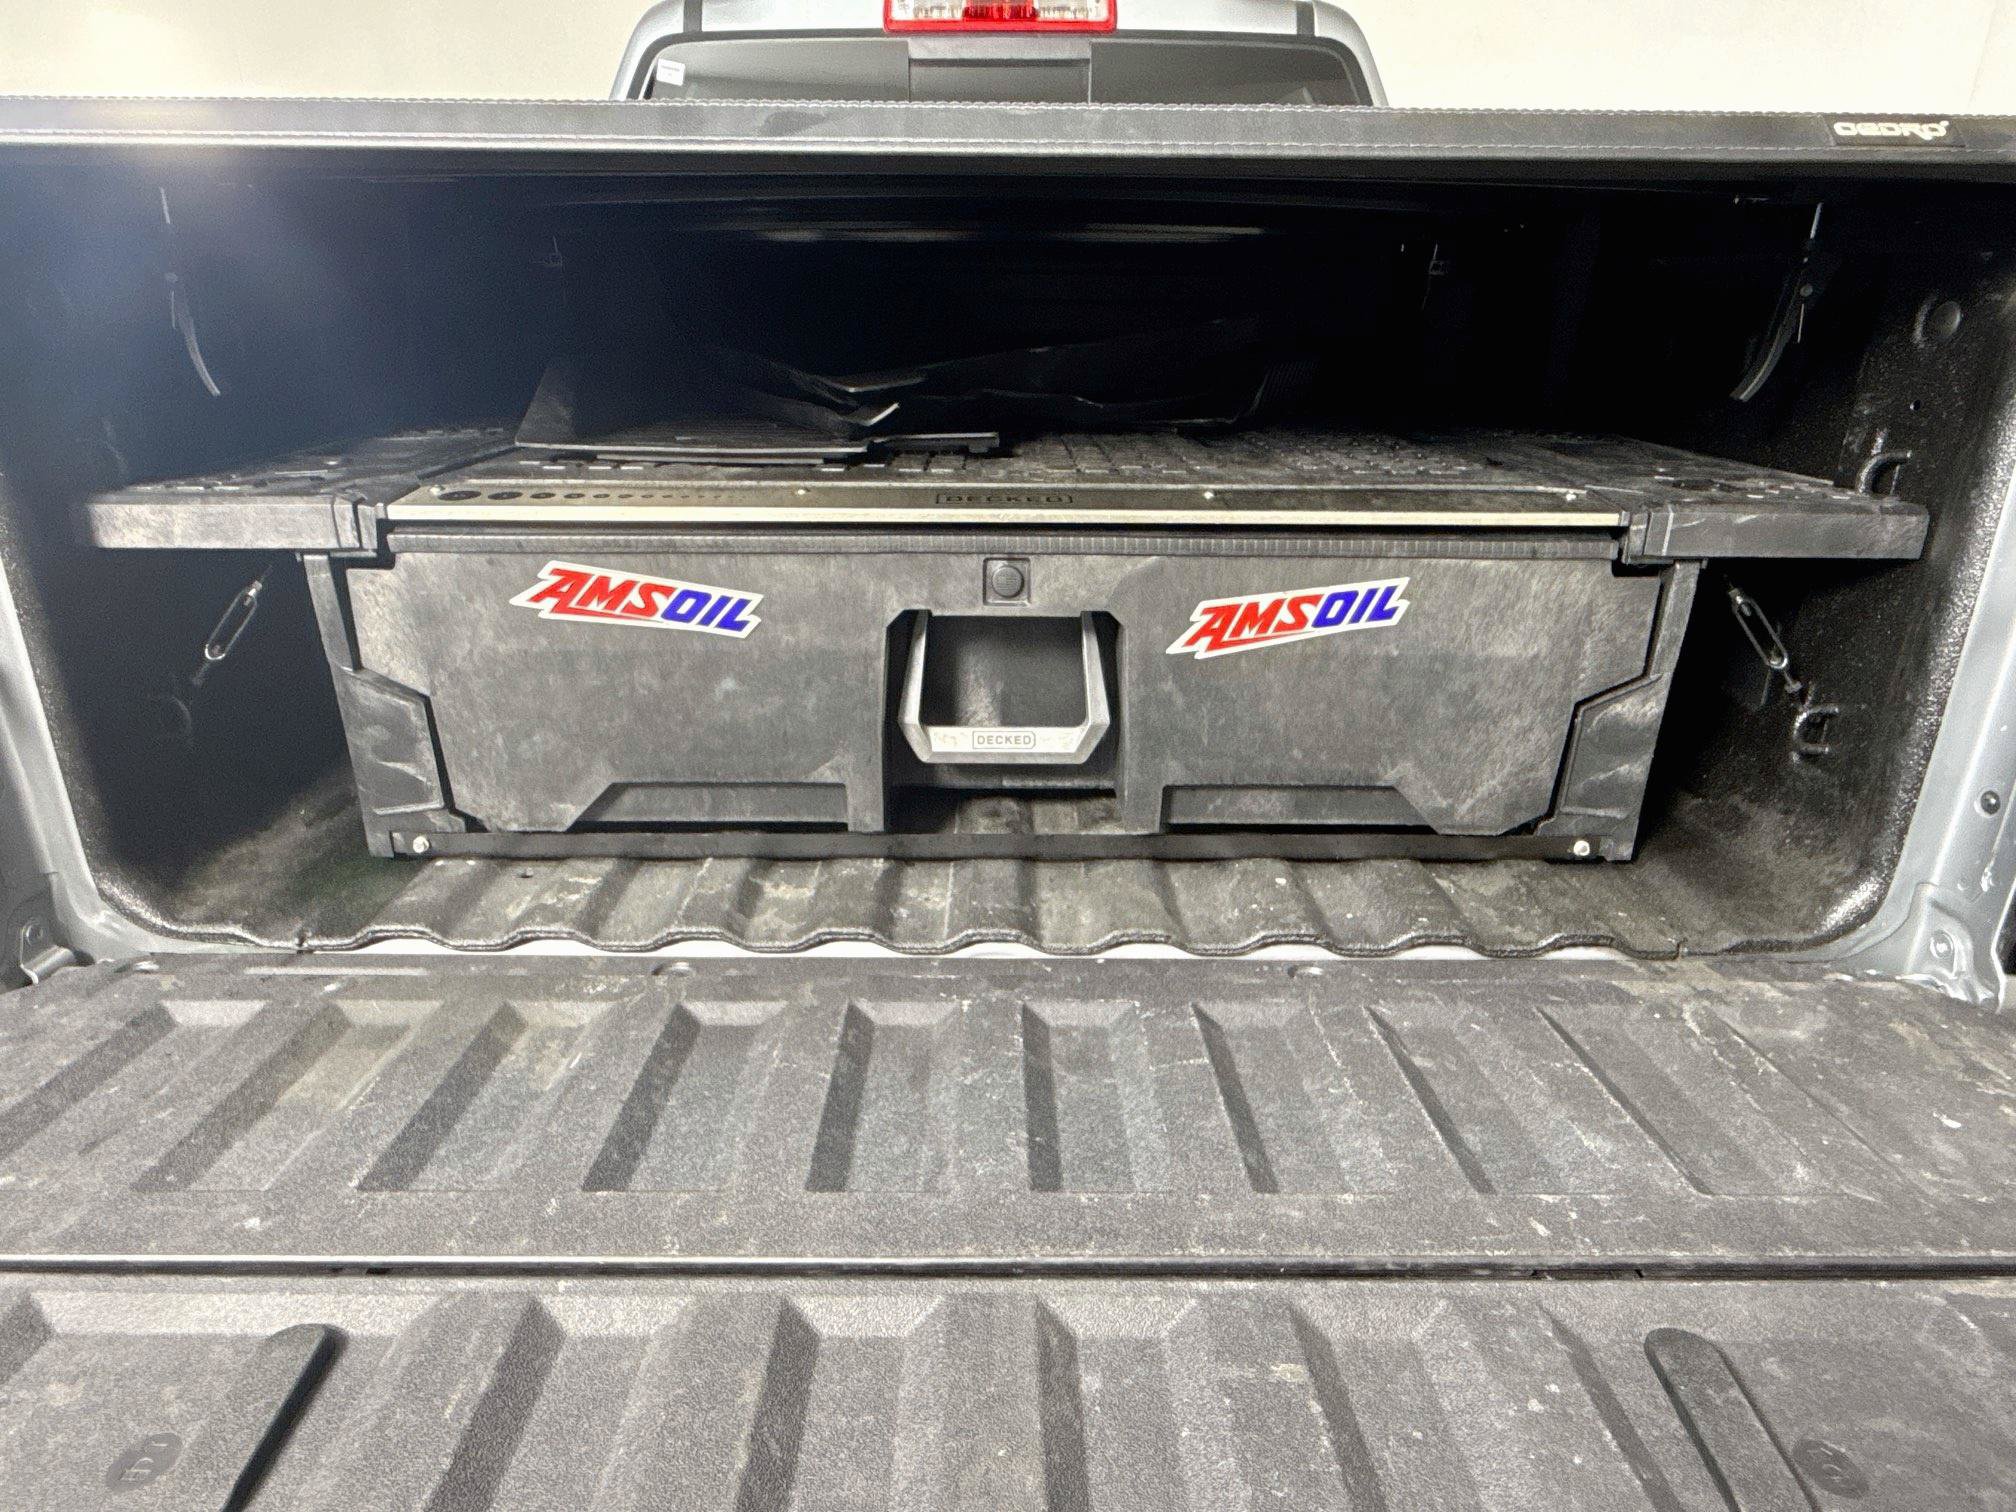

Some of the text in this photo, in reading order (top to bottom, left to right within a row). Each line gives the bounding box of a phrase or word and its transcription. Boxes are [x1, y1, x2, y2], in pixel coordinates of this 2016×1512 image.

[527, 567, 753, 632] AMSOIL
[1183, 585, 1400, 652] AMSOIL
[976, 734, 1032, 746] DECKED
